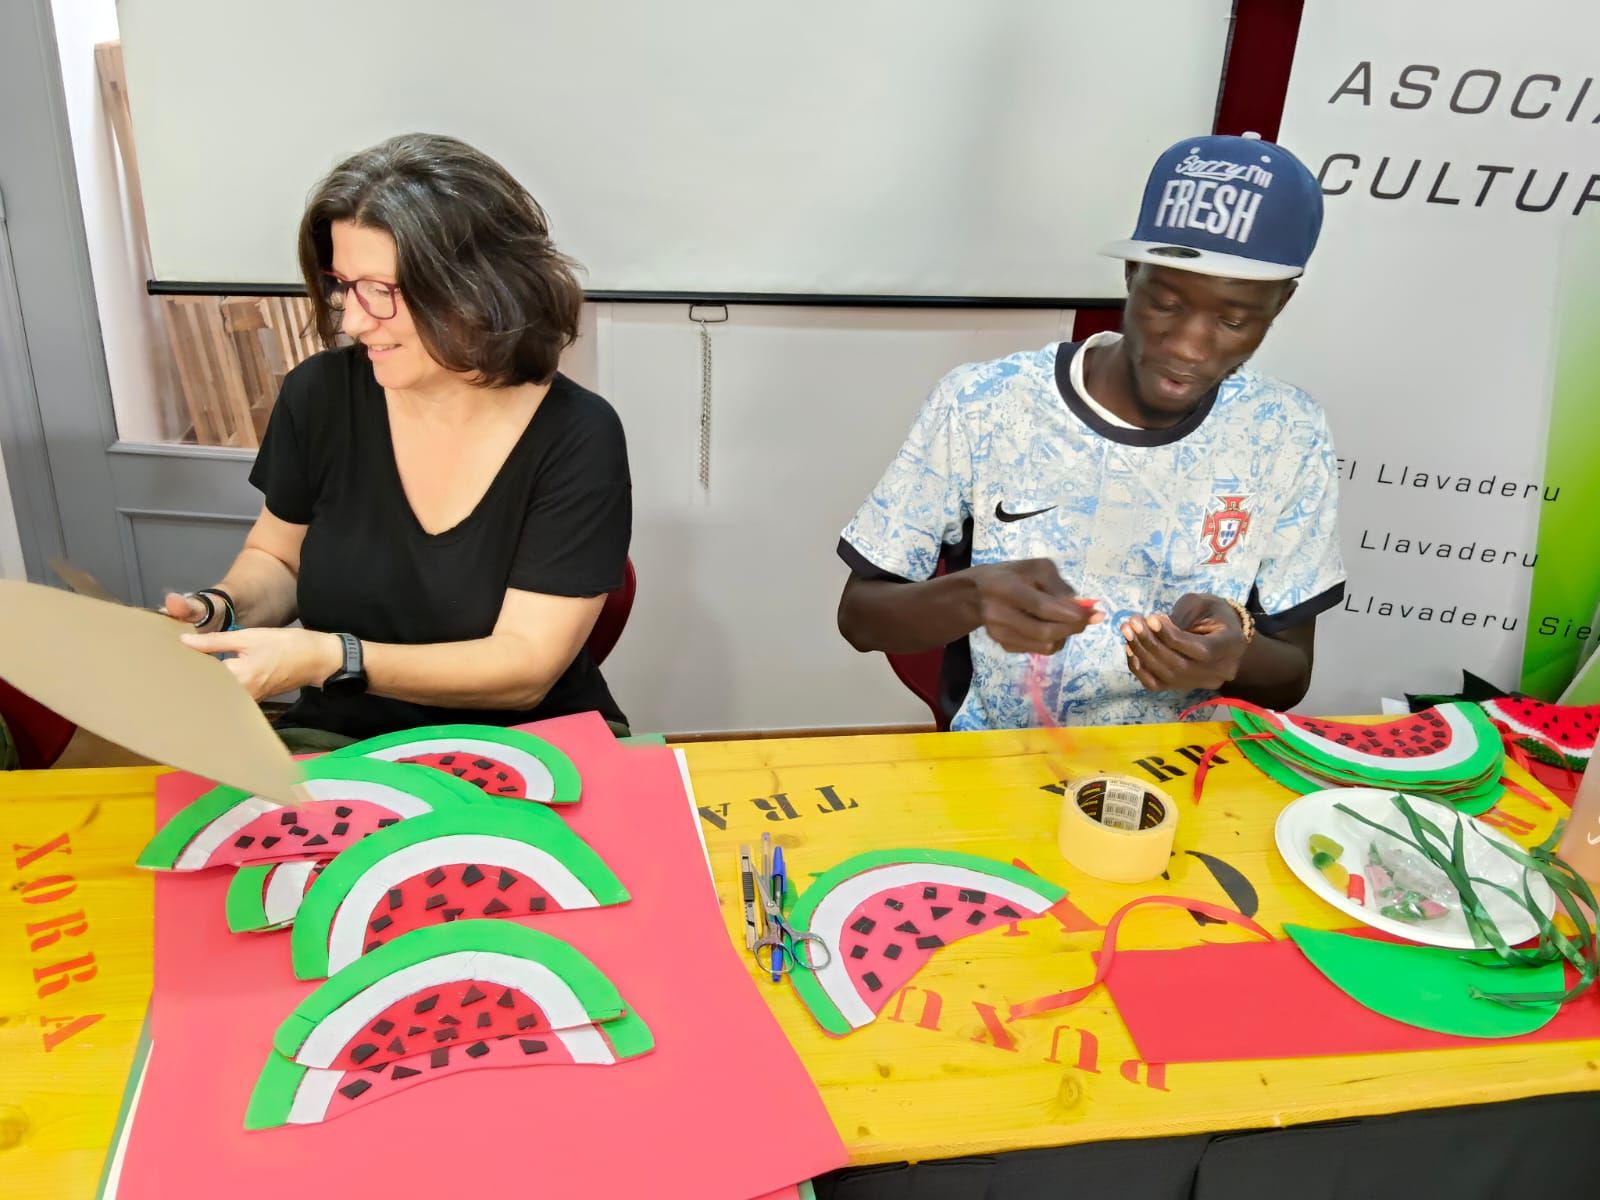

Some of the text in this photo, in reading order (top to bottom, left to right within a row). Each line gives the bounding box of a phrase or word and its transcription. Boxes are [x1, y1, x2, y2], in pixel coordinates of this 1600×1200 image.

[1327, 61, 1600, 124] ASOCI
[1175, 154, 1247, 181] Sorry
[1154, 179, 1264, 244] FRESH
[1377, 463, 1560, 502] Llavaderu
[1360, 530, 1539, 568] Llavaderu
[1344, 593, 1600, 642] Llavaderu Sie
[13, 832, 107, 1054] XORRA
